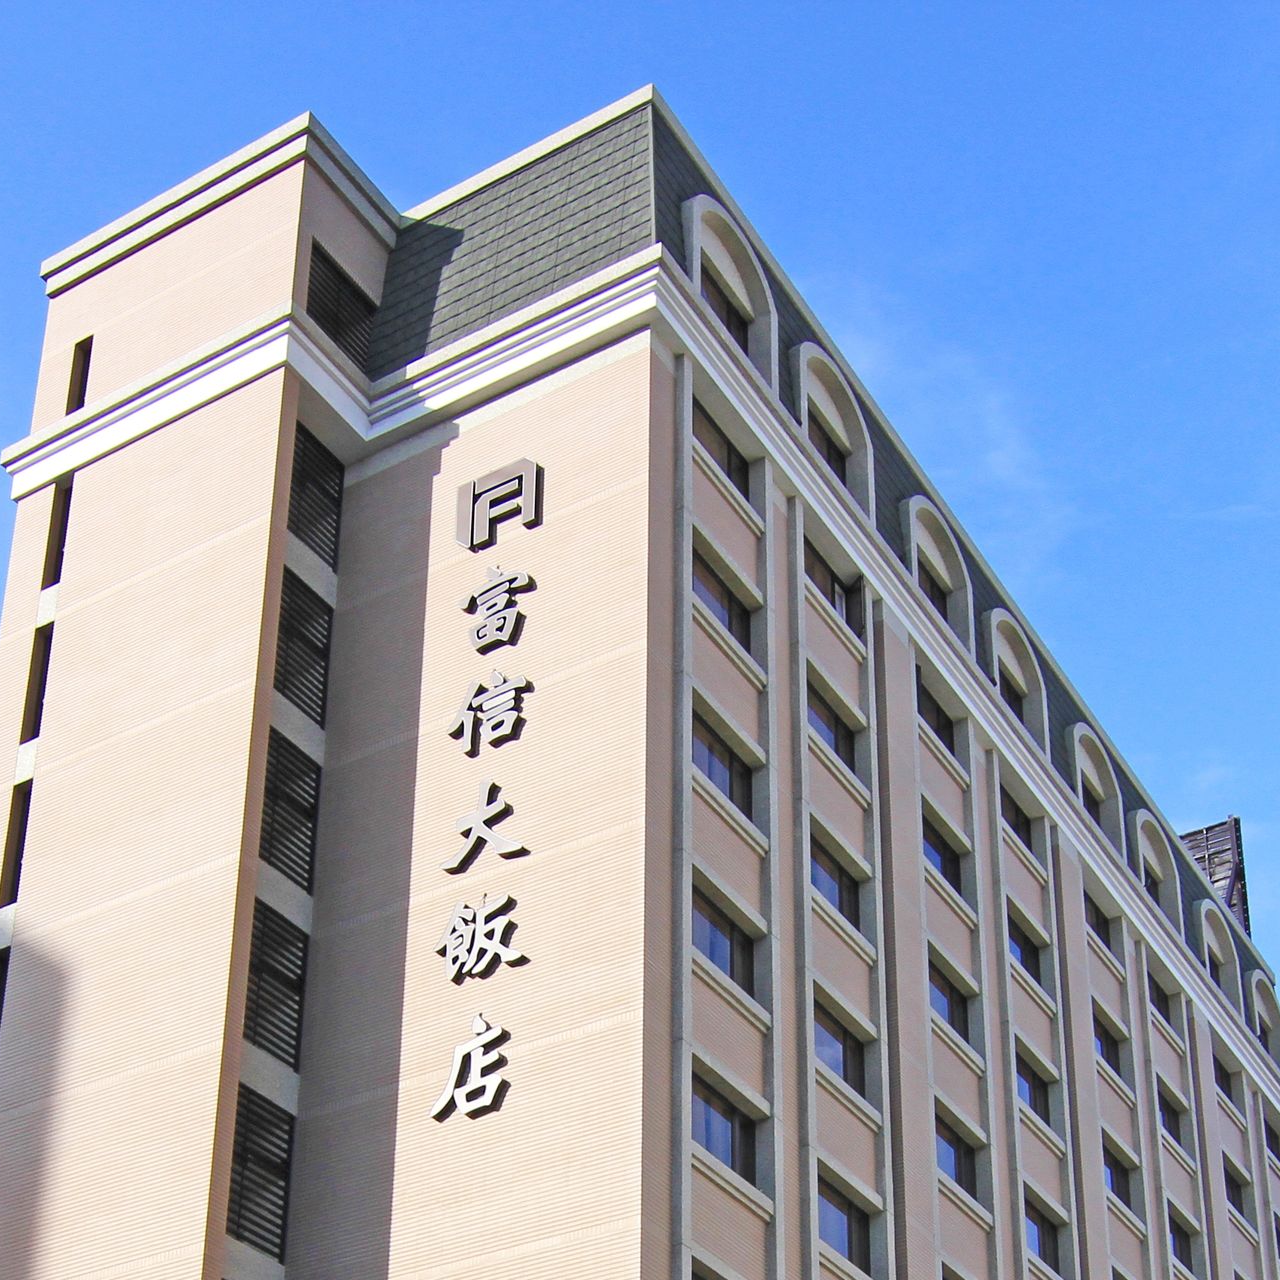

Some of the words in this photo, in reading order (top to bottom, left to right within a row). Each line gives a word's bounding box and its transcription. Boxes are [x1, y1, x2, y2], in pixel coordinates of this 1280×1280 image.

[430, 566, 535, 1122] 富信大飯店
